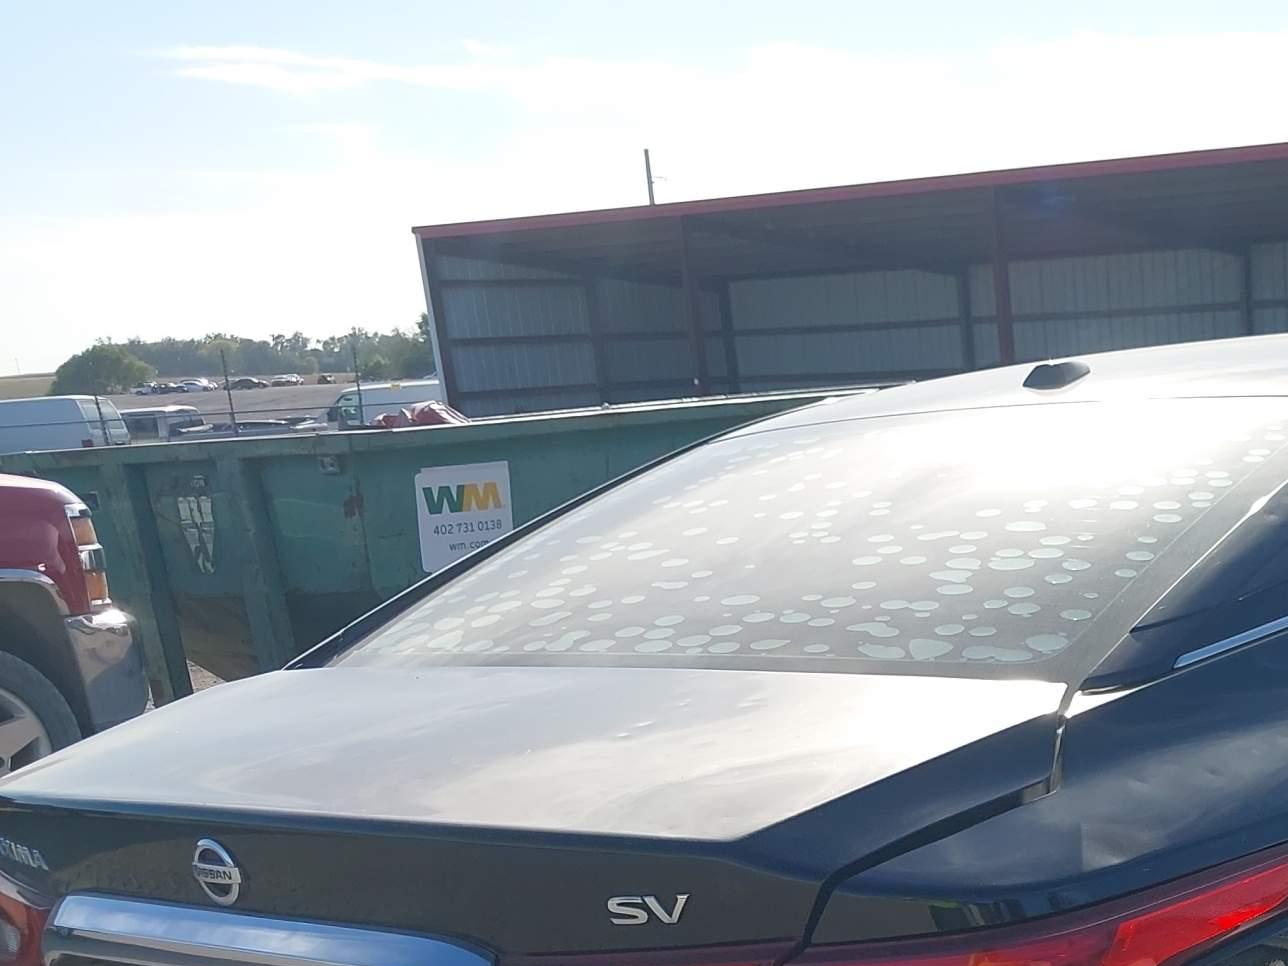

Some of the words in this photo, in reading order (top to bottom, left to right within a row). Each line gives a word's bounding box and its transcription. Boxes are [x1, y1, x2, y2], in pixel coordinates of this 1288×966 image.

[422, 482, 502, 515] WM
[433, 524, 454, 536] 402
[456, 522, 475, 533] 731
[477, 520, 502, 532] 0138
[607, 894, 690, 924] SV
